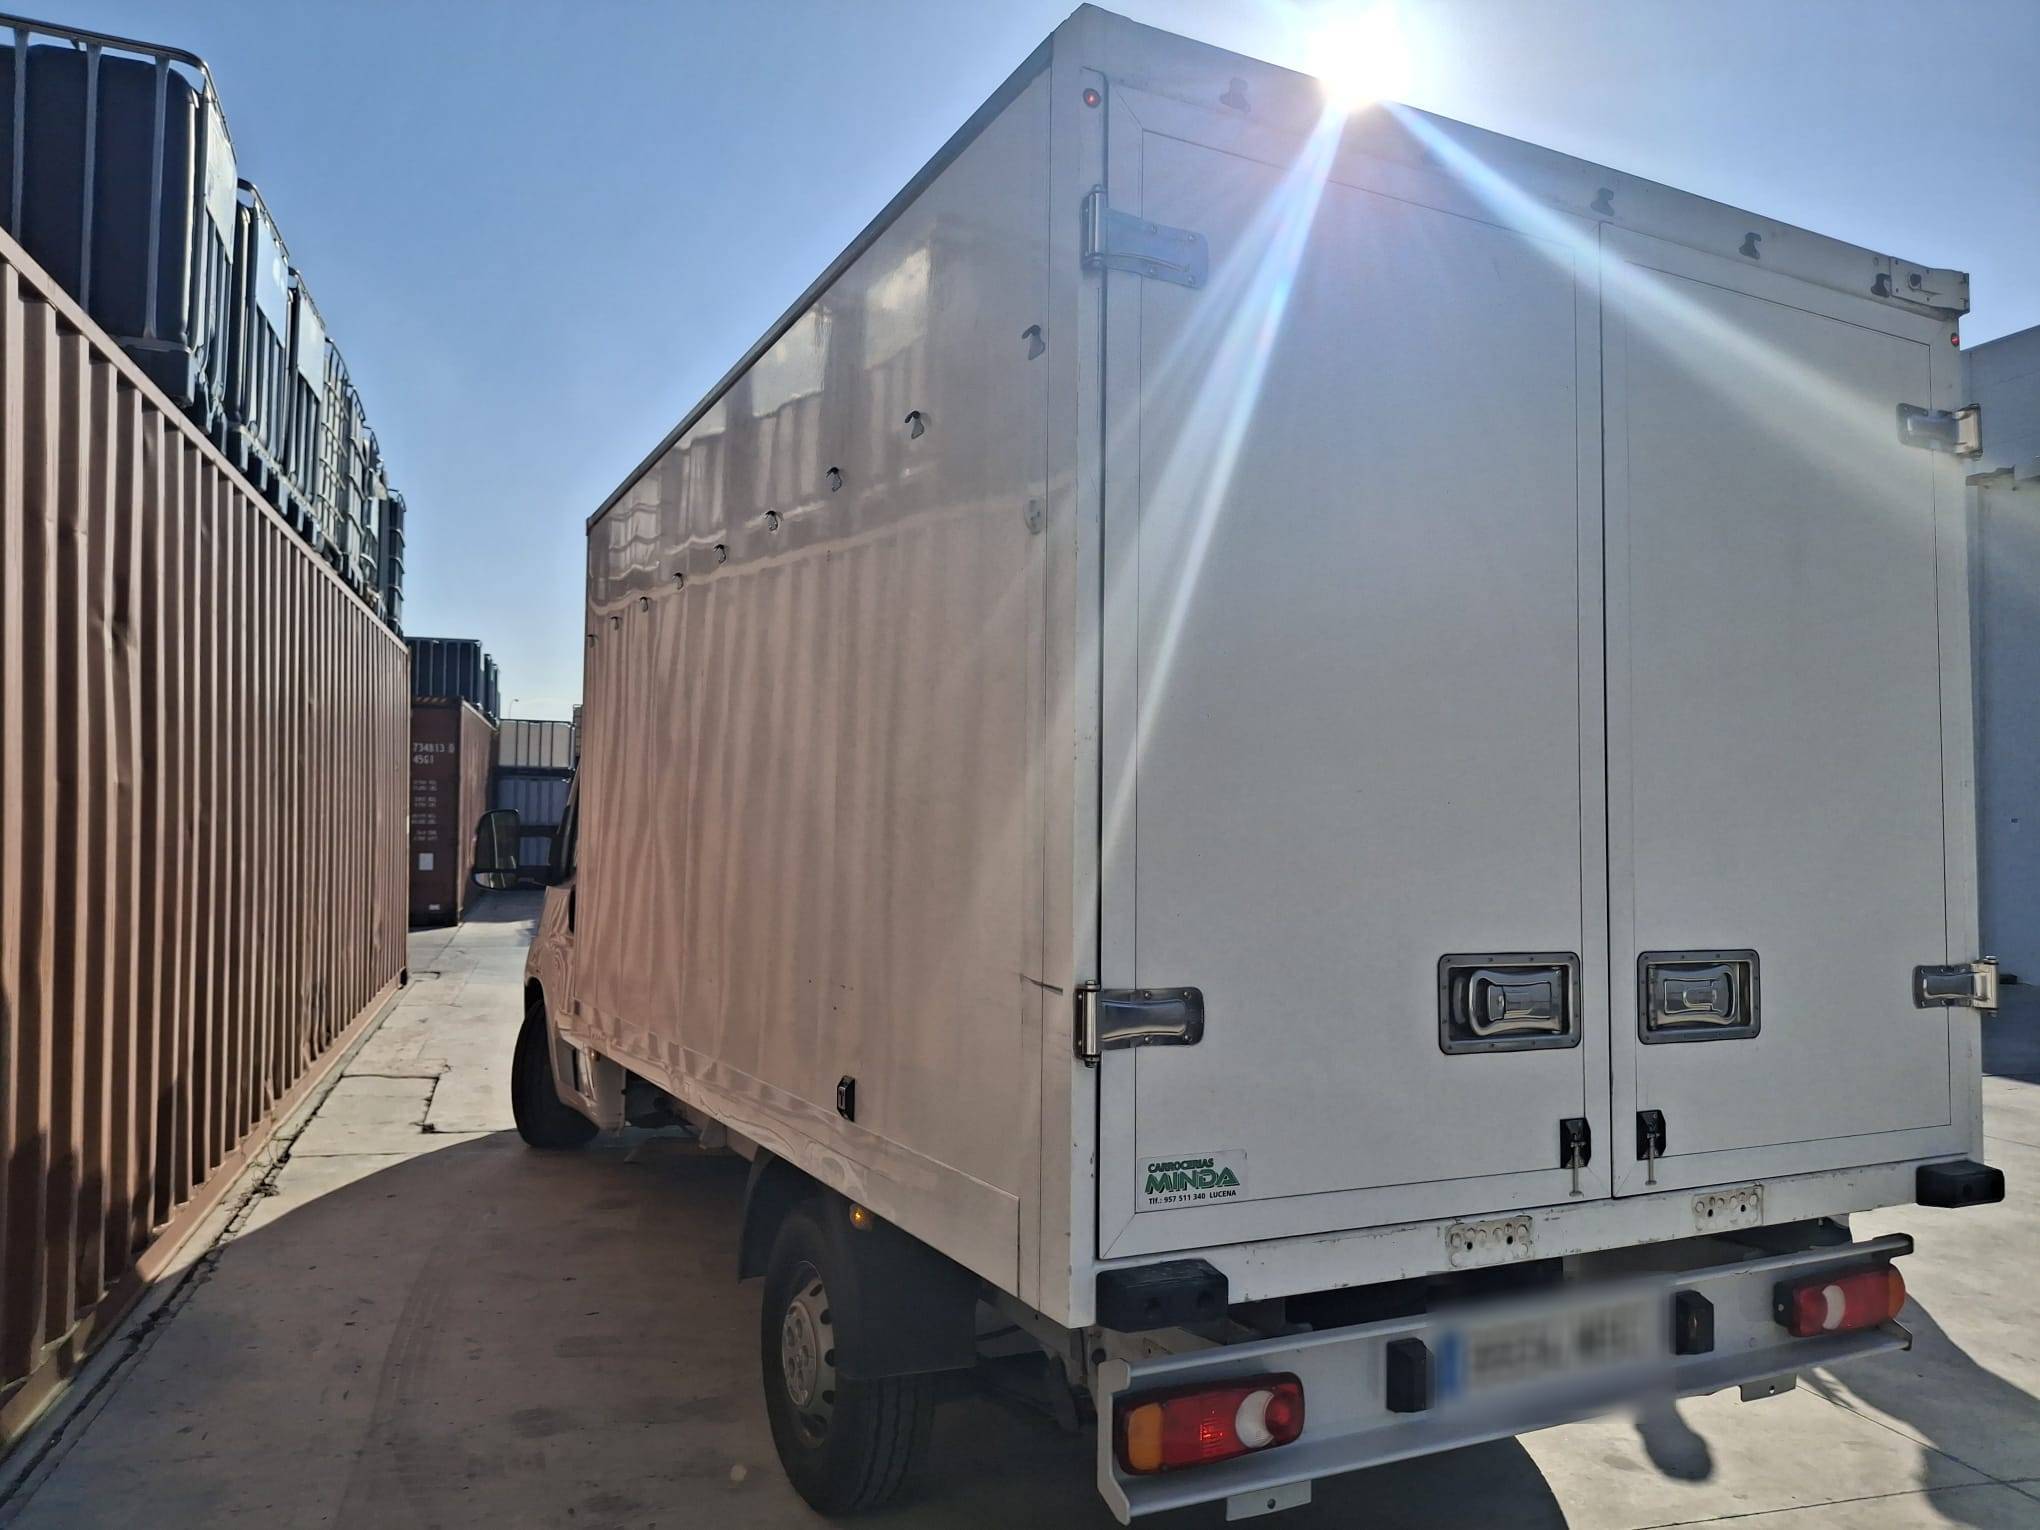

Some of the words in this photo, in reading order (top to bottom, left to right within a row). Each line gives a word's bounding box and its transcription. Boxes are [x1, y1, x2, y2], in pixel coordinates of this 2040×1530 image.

[1147, 1158, 1214, 1173] CARROCERIAS
[1145, 1167, 1240, 1194] MINDA
[1179, 1194, 1191, 1202] 511
[1209, 1190, 1237, 1199] LUCENA
